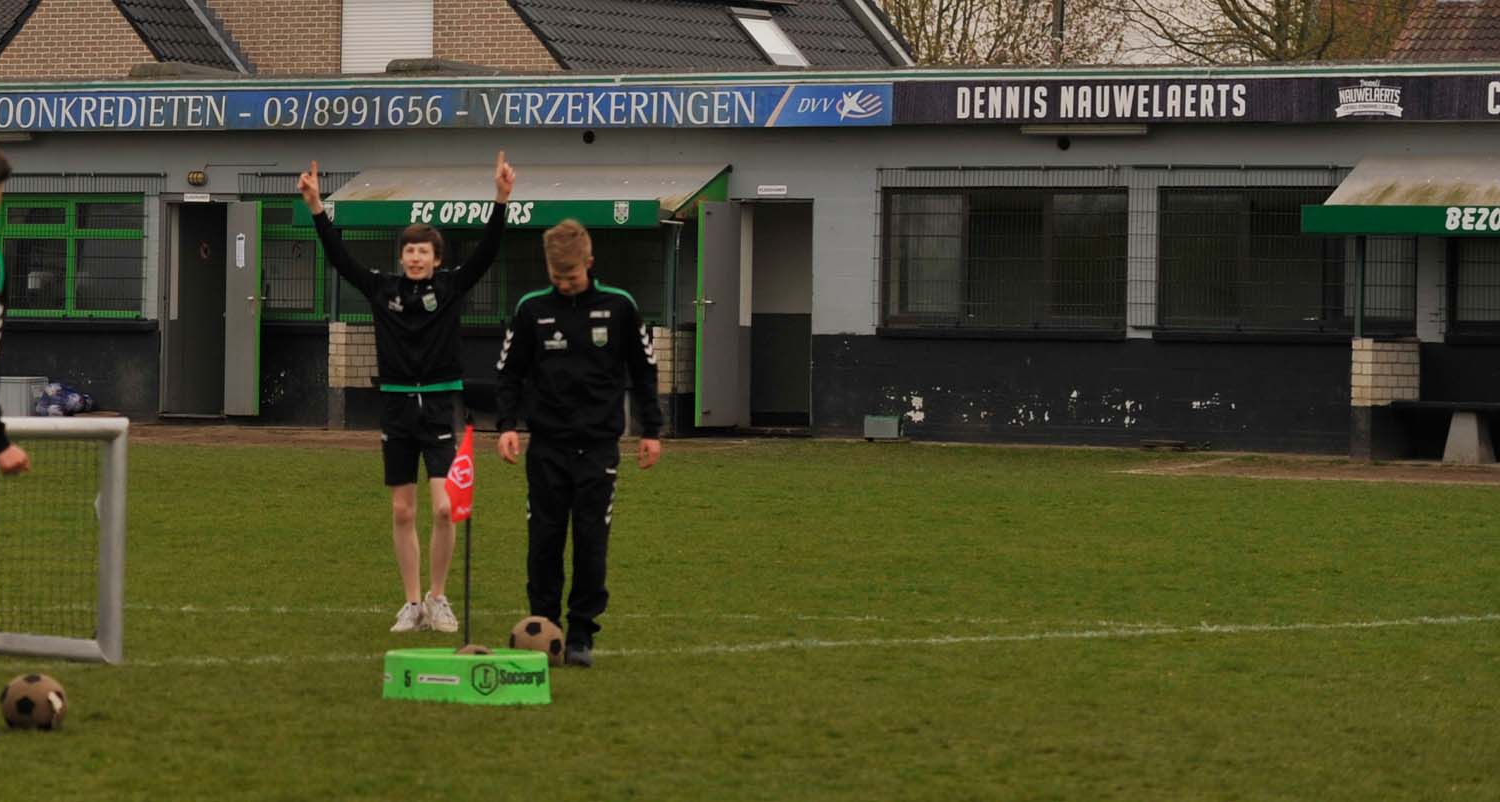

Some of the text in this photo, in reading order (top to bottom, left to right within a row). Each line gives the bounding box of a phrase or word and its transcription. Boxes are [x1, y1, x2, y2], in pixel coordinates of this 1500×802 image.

[797, 98, 836, 112] DVV
[957, 84, 1246, 118] DENNIS NAUWELAERTS
[1338, 87, 1401, 104] NAUWELAERTS
[263, 92, 443, 130] 03/8991656
[480, 91, 757, 126] VERZEKERINGEN
[410, 201, 534, 224] FC OPPURS
[1445, 207, 1500, 231] BEZO
